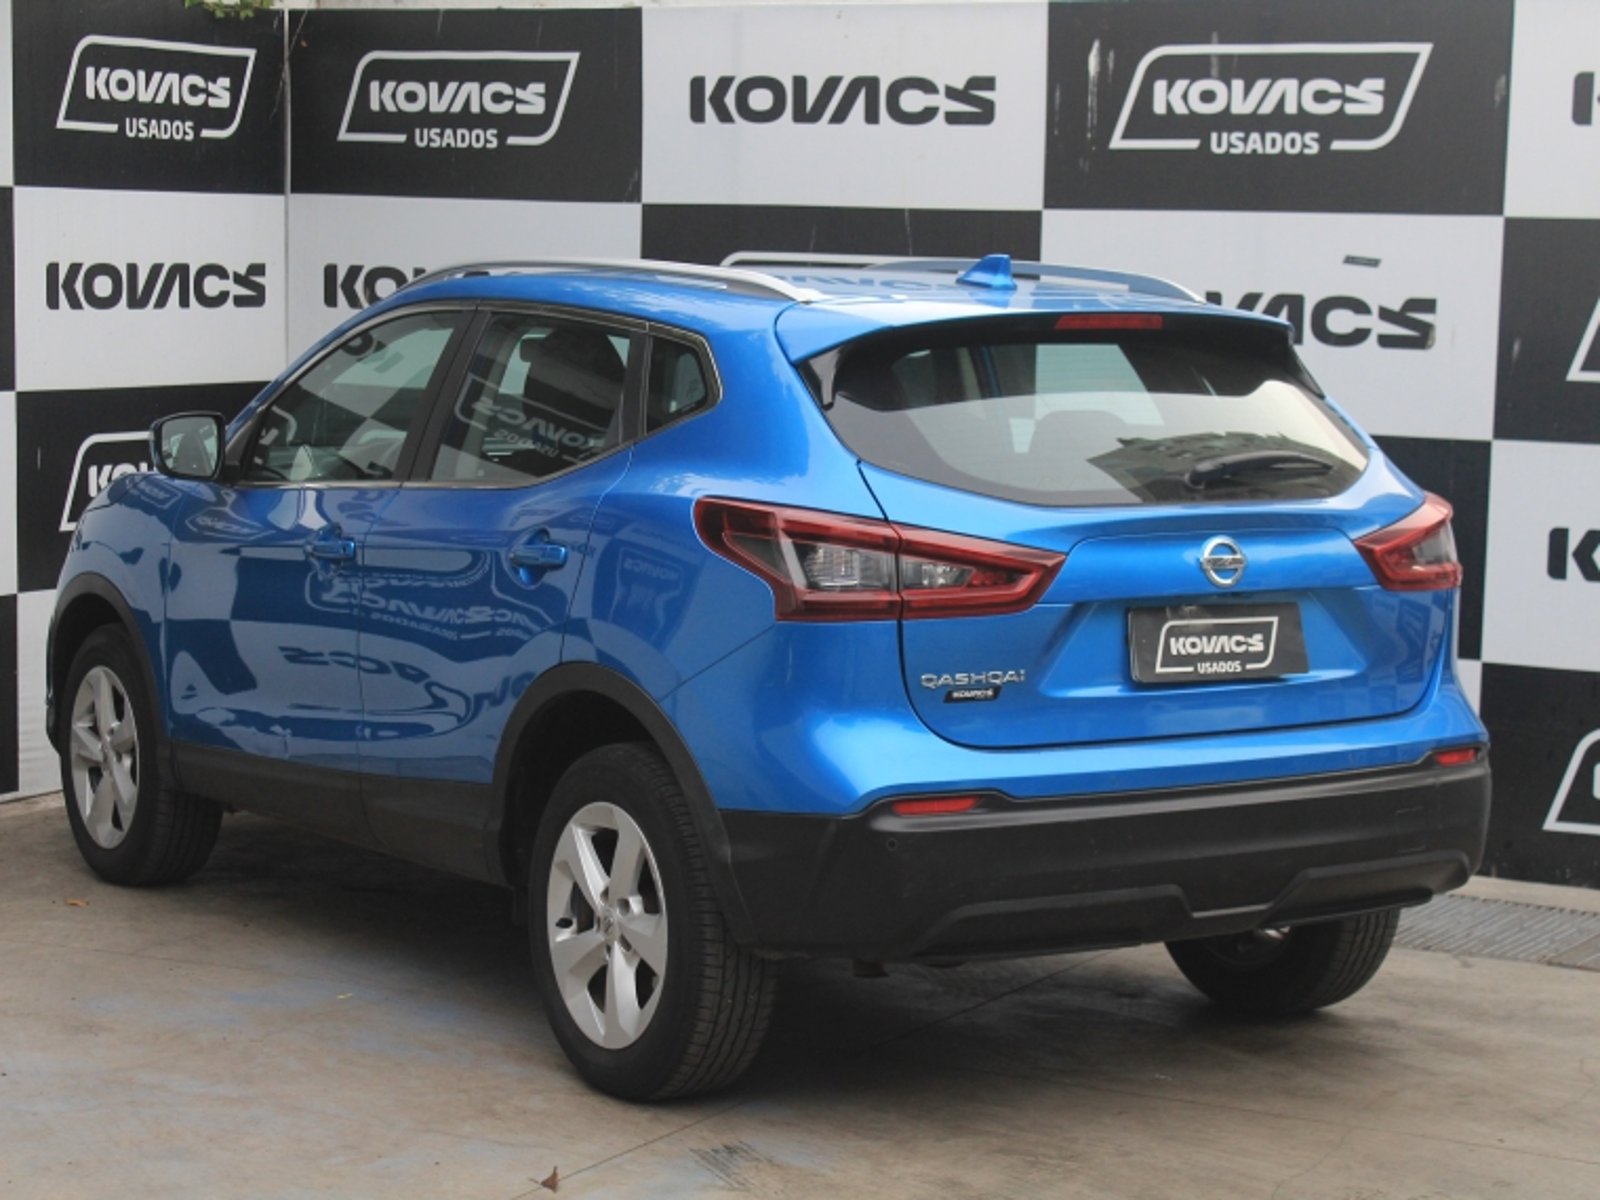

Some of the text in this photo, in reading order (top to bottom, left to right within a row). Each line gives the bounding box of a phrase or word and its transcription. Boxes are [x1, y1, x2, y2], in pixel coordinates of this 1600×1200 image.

[86, 67, 231, 108] KOVACS
[369, 80, 546, 114] KOVACS
[690, 75, 995, 126] KOVACS
[1152, 78, 1385, 115] KOVACS
[125, 117, 195, 142] USADOS
[414, 128, 498, 149] USADOS
[1210, 131, 1320, 155] USADOS
[46, 262, 266, 310] KOVACS
[1169, 633, 1264, 655] KOVACS
[1197, 660, 1242, 674] USADOS
